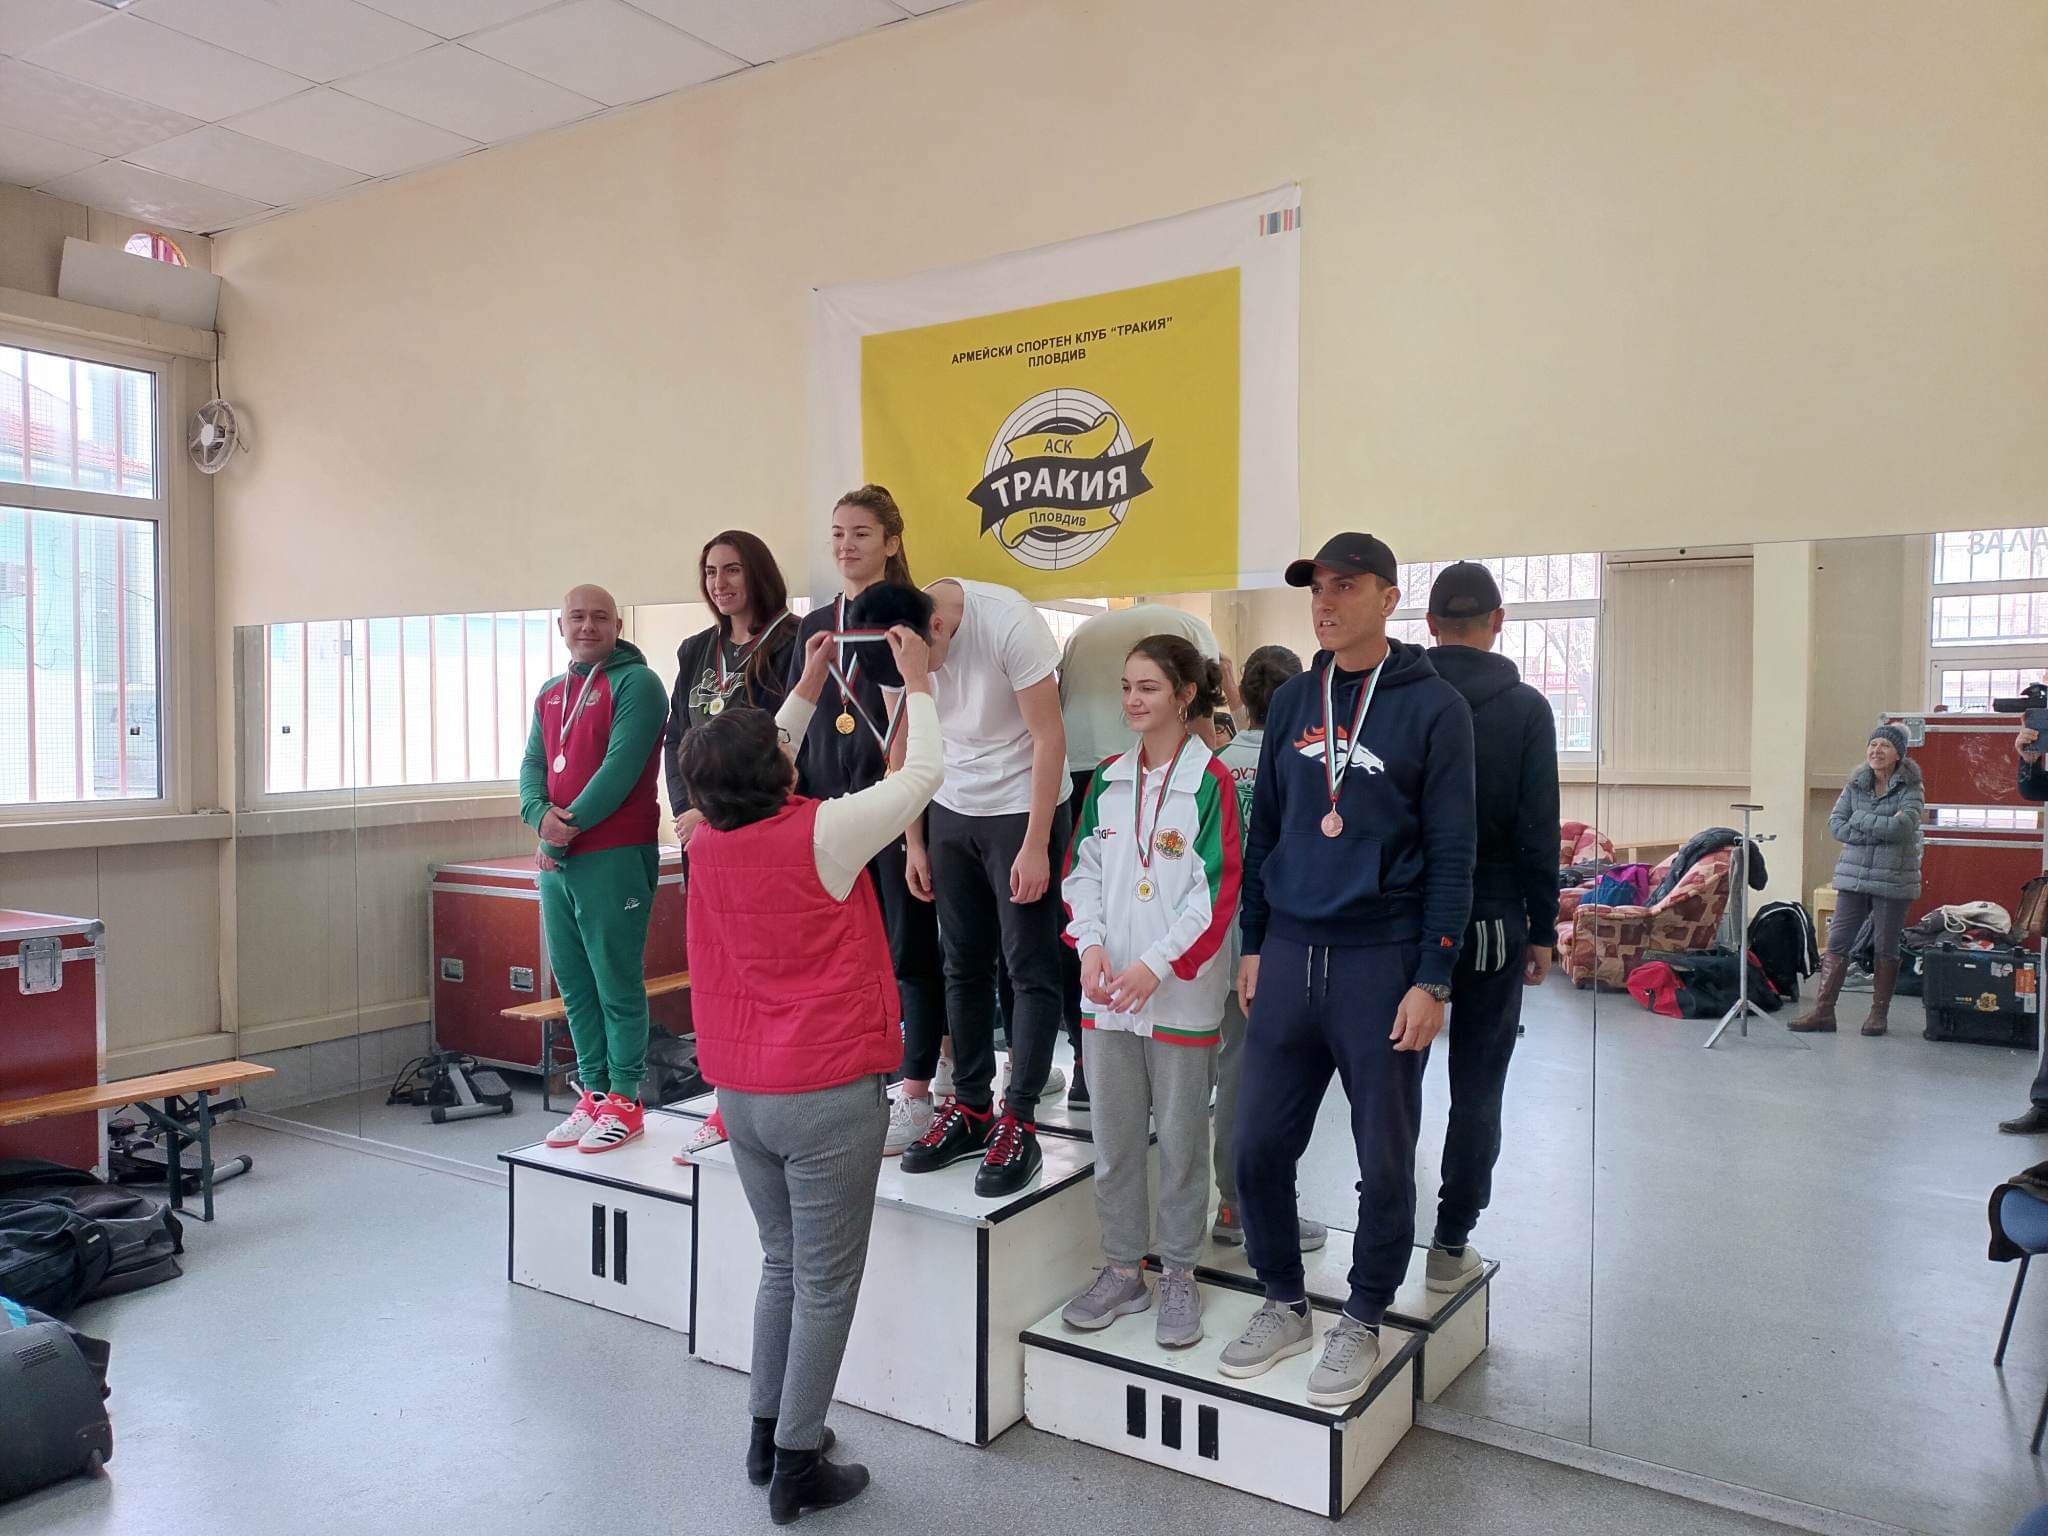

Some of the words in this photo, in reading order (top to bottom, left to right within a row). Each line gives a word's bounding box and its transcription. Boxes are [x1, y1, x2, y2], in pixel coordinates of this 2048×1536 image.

[951, 345, 1013, 364] АРМЕЙСКИ
[1016, 335, 1072, 354] СПОРТЕН
[1075, 328, 1107, 344] КЛУБ
[1028, 348, 1086, 367] ПЛОВДИВ
[1043, 439, 1073, 454] АСК
[990, 465, 1127, 507] ТРАКИЯ
[1029, 511, 1087, 527] Пловдив
